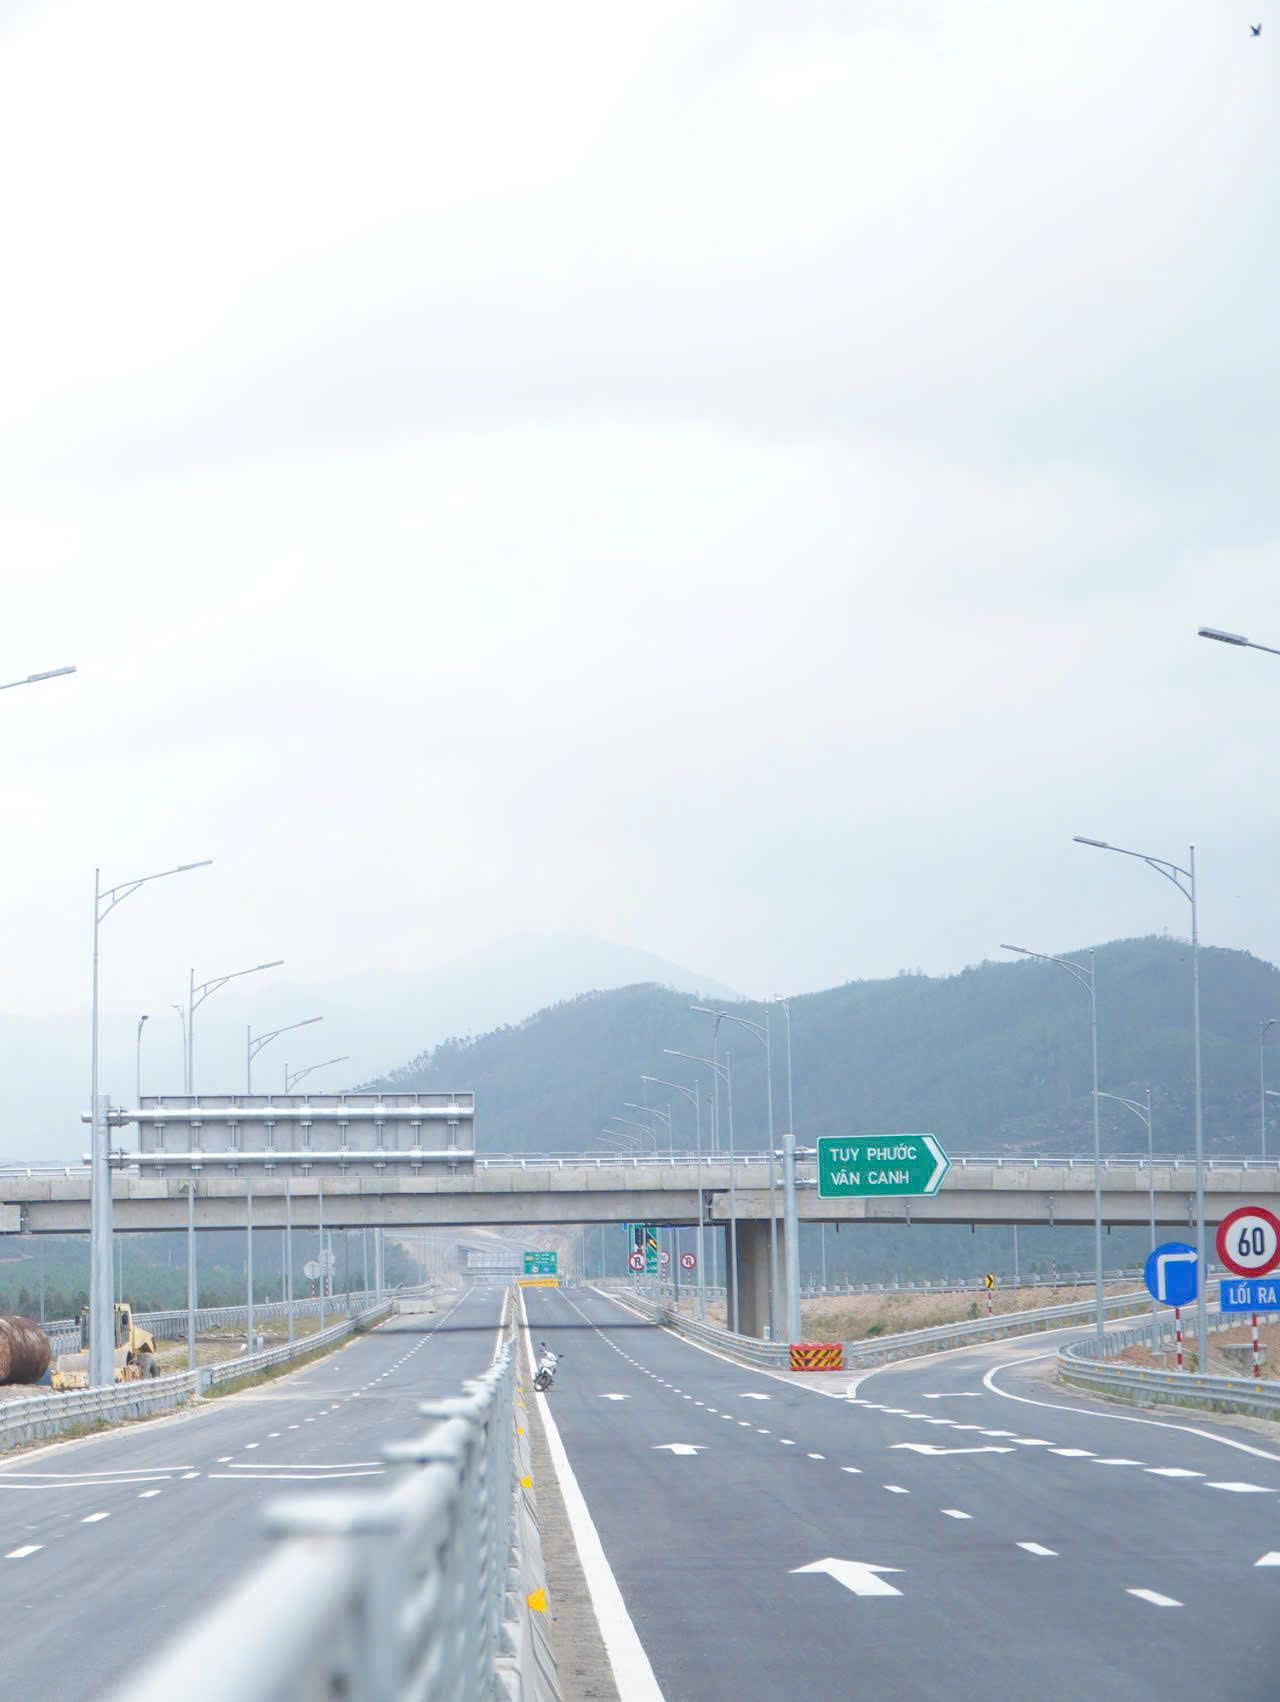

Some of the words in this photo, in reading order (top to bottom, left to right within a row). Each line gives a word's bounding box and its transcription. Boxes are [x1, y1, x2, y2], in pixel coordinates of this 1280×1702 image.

[830, 1148, 860, 1162] TUY
[868, 1143, 918, 1161] PHƯỚC
[831, 1169, 861, 1185] VÂN
[868, 1170, 909, 1185] CANH
[1238, 1226, 1265, 1257] 60
[1229, 1282, 1251, 1305] LỐI
[1258, 1287, 1277, 1304] RA
